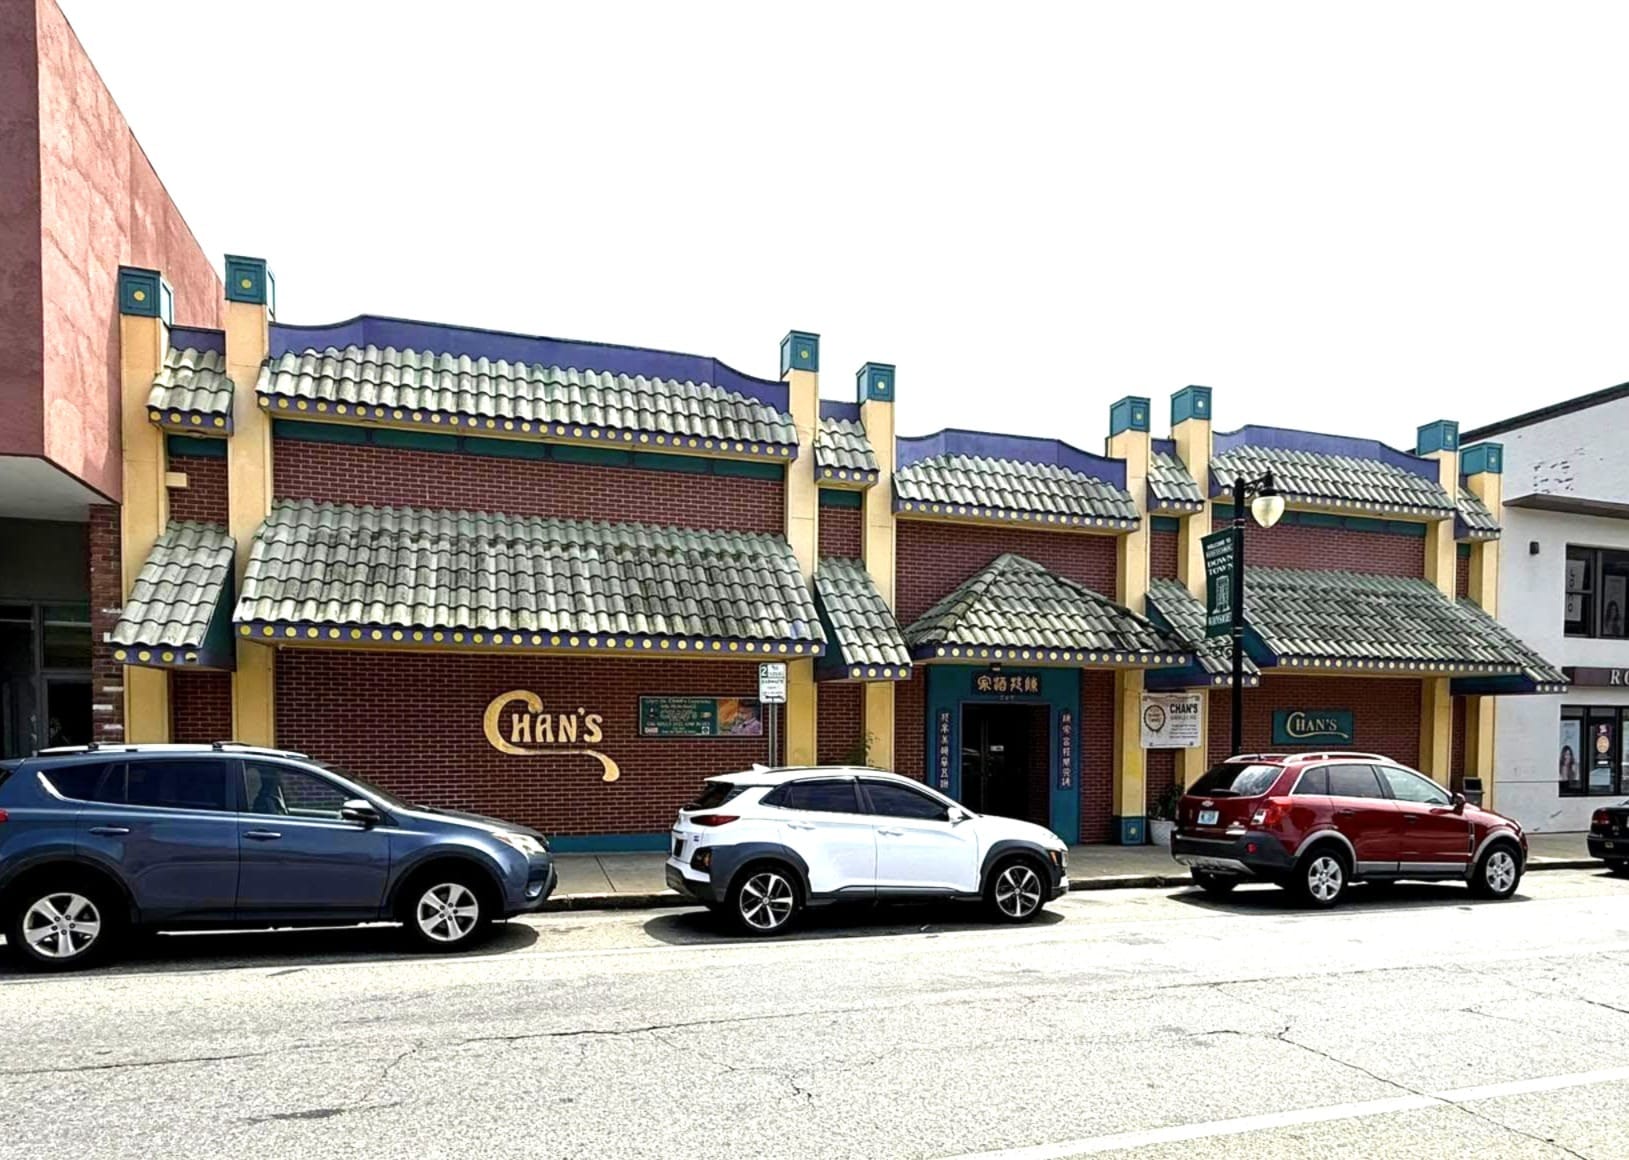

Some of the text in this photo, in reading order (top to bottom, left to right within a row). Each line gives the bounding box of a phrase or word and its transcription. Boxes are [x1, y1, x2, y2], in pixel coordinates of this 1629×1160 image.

[1207, 554, 1233, 568] DOWN
[1208, 563, 1233, 575] TOWN
[761, 666, 767, 677] 2
[1170, 703, 1198, 713] CHAN'S
[1286, 711, 1349, 738] CHAN'S
[483, 690, 620, 782] CHAN'S
